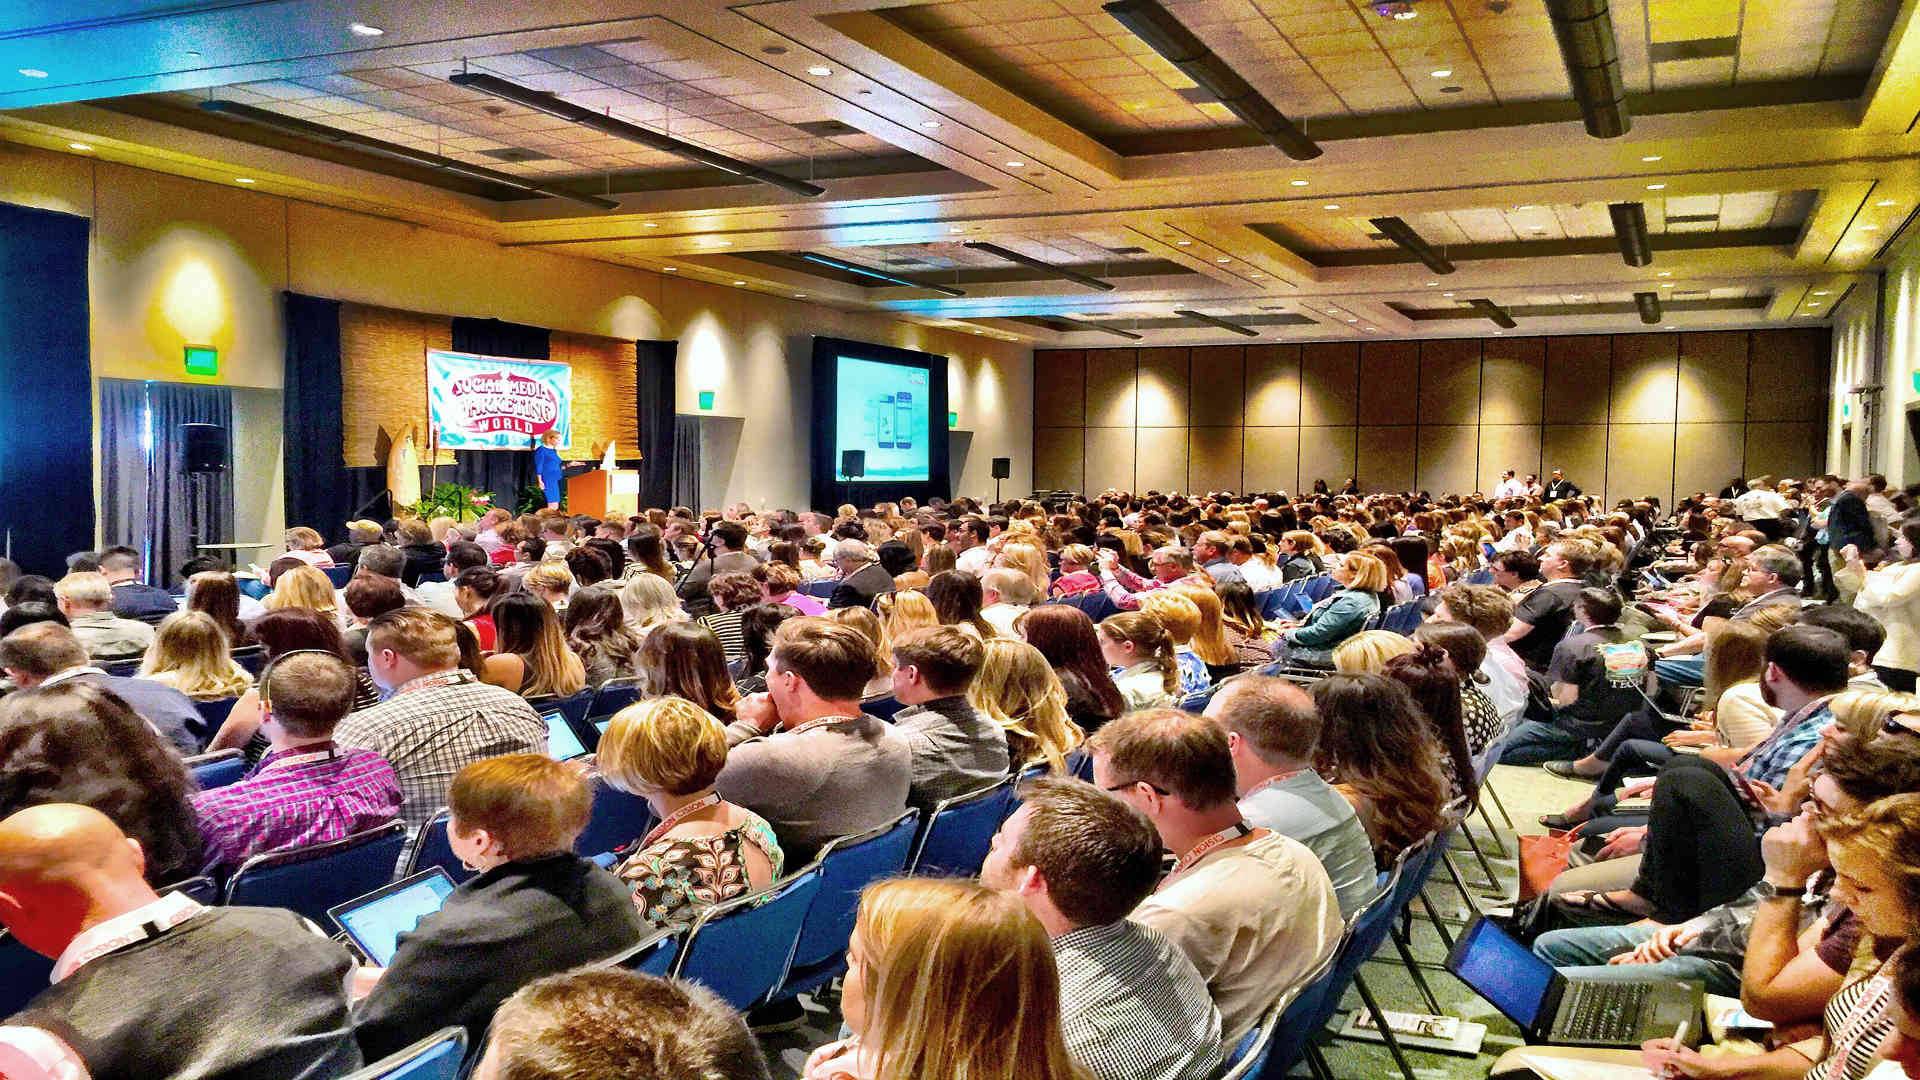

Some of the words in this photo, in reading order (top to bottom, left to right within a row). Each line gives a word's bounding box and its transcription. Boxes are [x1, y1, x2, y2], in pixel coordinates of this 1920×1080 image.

[453, 378, 504, 396] SOCIAL
[507, 379, 552, 402] MEDIA
[457, 394, 553, 423] ARKETING
[478, 418, 533, 434] WORLD
[1192, 834, 1225, 856] CISION
